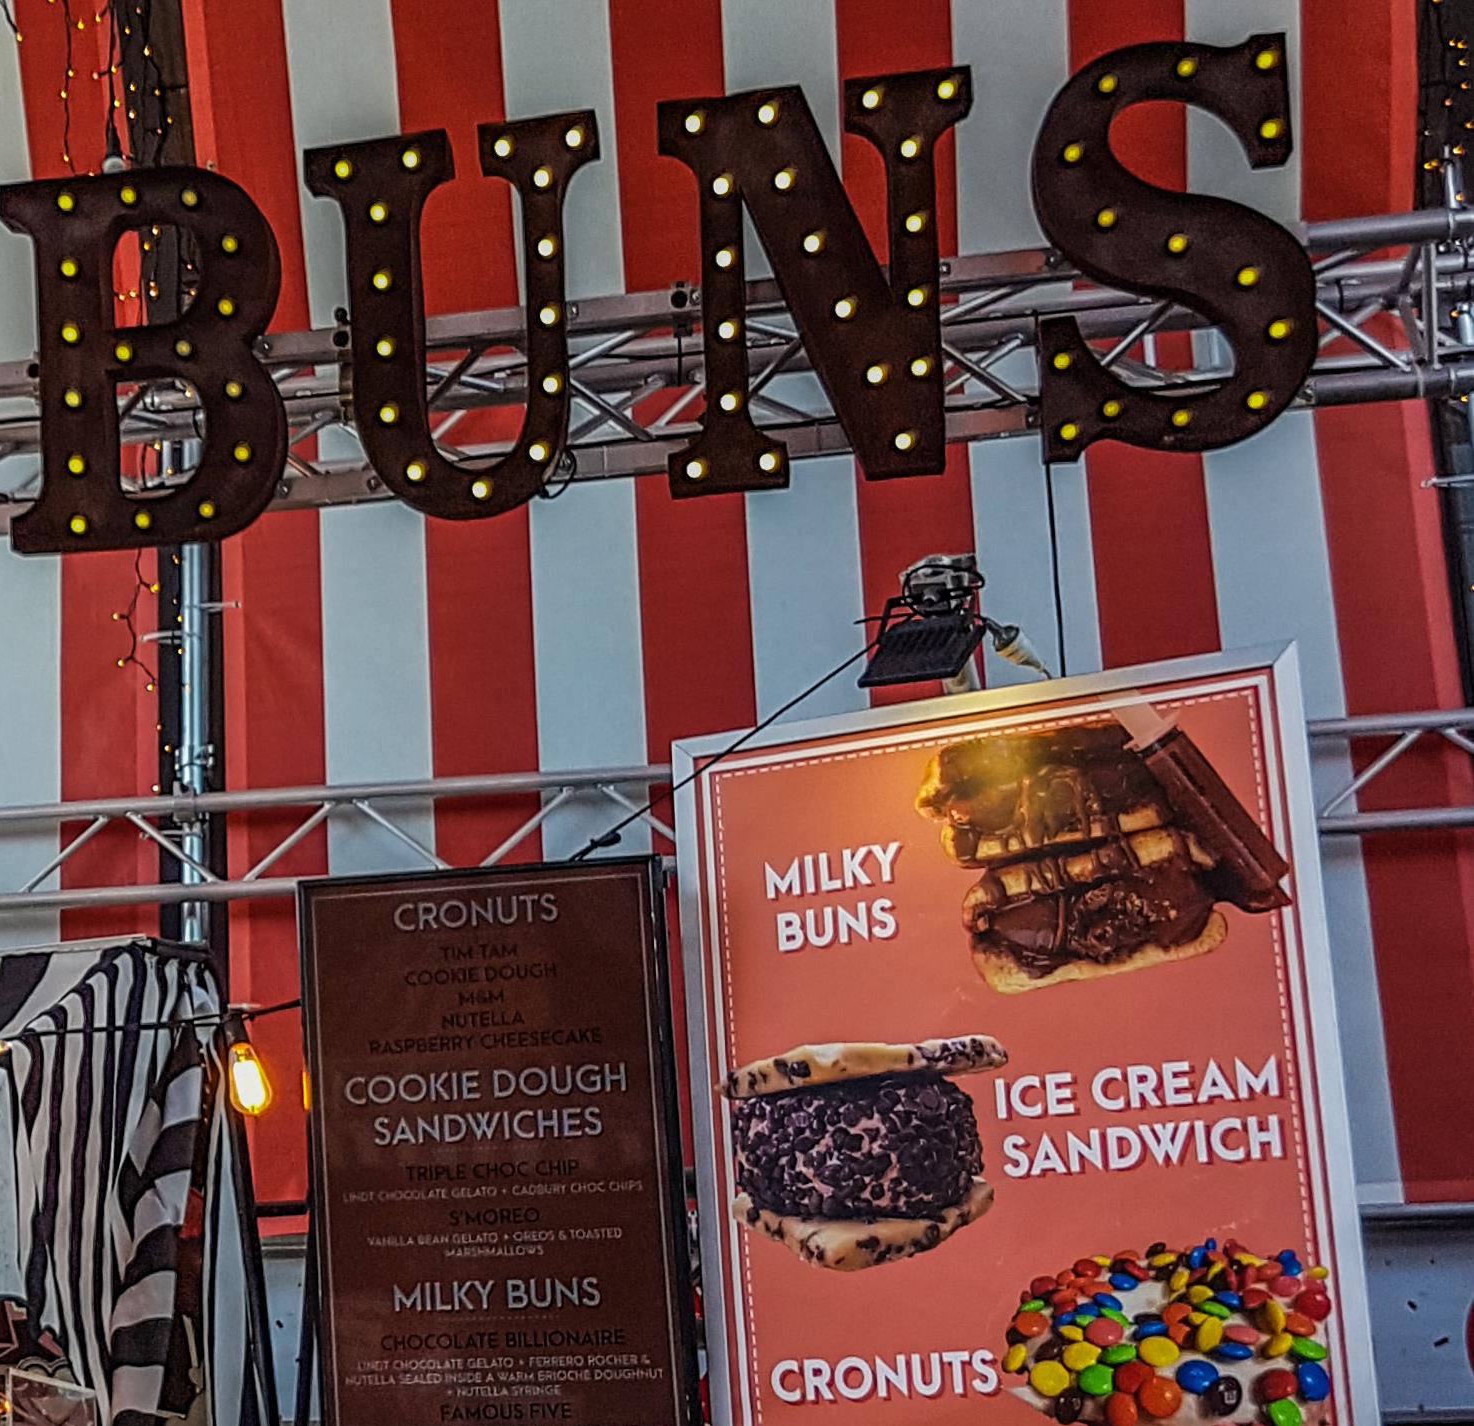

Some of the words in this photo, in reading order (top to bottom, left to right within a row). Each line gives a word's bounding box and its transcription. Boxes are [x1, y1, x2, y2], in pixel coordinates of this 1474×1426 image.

[0, 33, 1317, 555] BUNS
[764, 841, 901, 899] MILKY
[394, 894, 559, 931] CRONUTS
[777, 898, 897, 952] BUNS
[439, 946, 474, 960] TIM
[479, 944, 518, 959] TAM
[405, 967, 479, 986] COOKIE
[484, 963, 557, 982] DOUGH
[441, 1011, 525, 1029] NUTELLA
[369, 1035, 474, 1054] RASPBERRY
[480, 1027, 603, 1049] CHEESECAKE
[344, 1070, 481, 1105] COOKIE
[493, 1062, 627, 1098] DOUGH
[994, 1072, 1075, 1120] ICE
[1090, 1054, 1280, 1111] CREAM
[374, 1107, 603, 1146] SANDWICHES
[1003, 1115, 1283, 1178] SANDWICH
[405, 1164, 466, 1181] TRIPLE
[473, 1161, 529, 1179] CHOC
[535, 1159, 580, 1177] CHIP
[451, 1186, 497, 1198] GELATO
[512, 1184, 567, 1196] CADBURY
[570, 1181, 606, 1193] CHOC
[608, 1180, 644, 1192] CHIPS
[449, 1207, 540, 1226] S'MOREO
[367, 1235, 414, 1247] VANILLA
[417, 1234, 449, 1245] BEAN
[452, 1232, 499, 1244] GELATO
[512, 1230, 555, 1242] OREOS
[570, 1227, 623, 1239] TOASTED
[445, 1245, 544, 1257] MARSHMALLOWS
[393, 1279, 494, 1312] MILKY
[506, 1276, 601, 1309] BUNS
[381, 1332, 498, 1351] CHOCOLATE
[504, 1329, 626, 1348] BILLIONAIRE
[393, 1358, 464, 1370] CHOCOLATE
[466, 1357, 513, 1369] GELATO
[528, 1356, 583, 1368] FERRERO
[587, 1354, 638, 1366] ROCHER
[345, 1374, 396, 1385] NUTELLA
[398, 1373, 442, 1384] SEALED
[445, 1372, 482, 1383] INSIDE
[485, 1372, 494, 1382] A
[497, 1371, 534, 1382] WARM
[537, 1370, 591, 1381] BRIOCHE
[594, 1368, 663, 1380] DOUGHNUT
[771, 1349, 999, 1403] CRONUTS
[457, 1386, 509, 1397] NUTELLA
[440, 1403, 523, 1421] FAMOUS
[529, 1402, 572, 1419] FIVE
